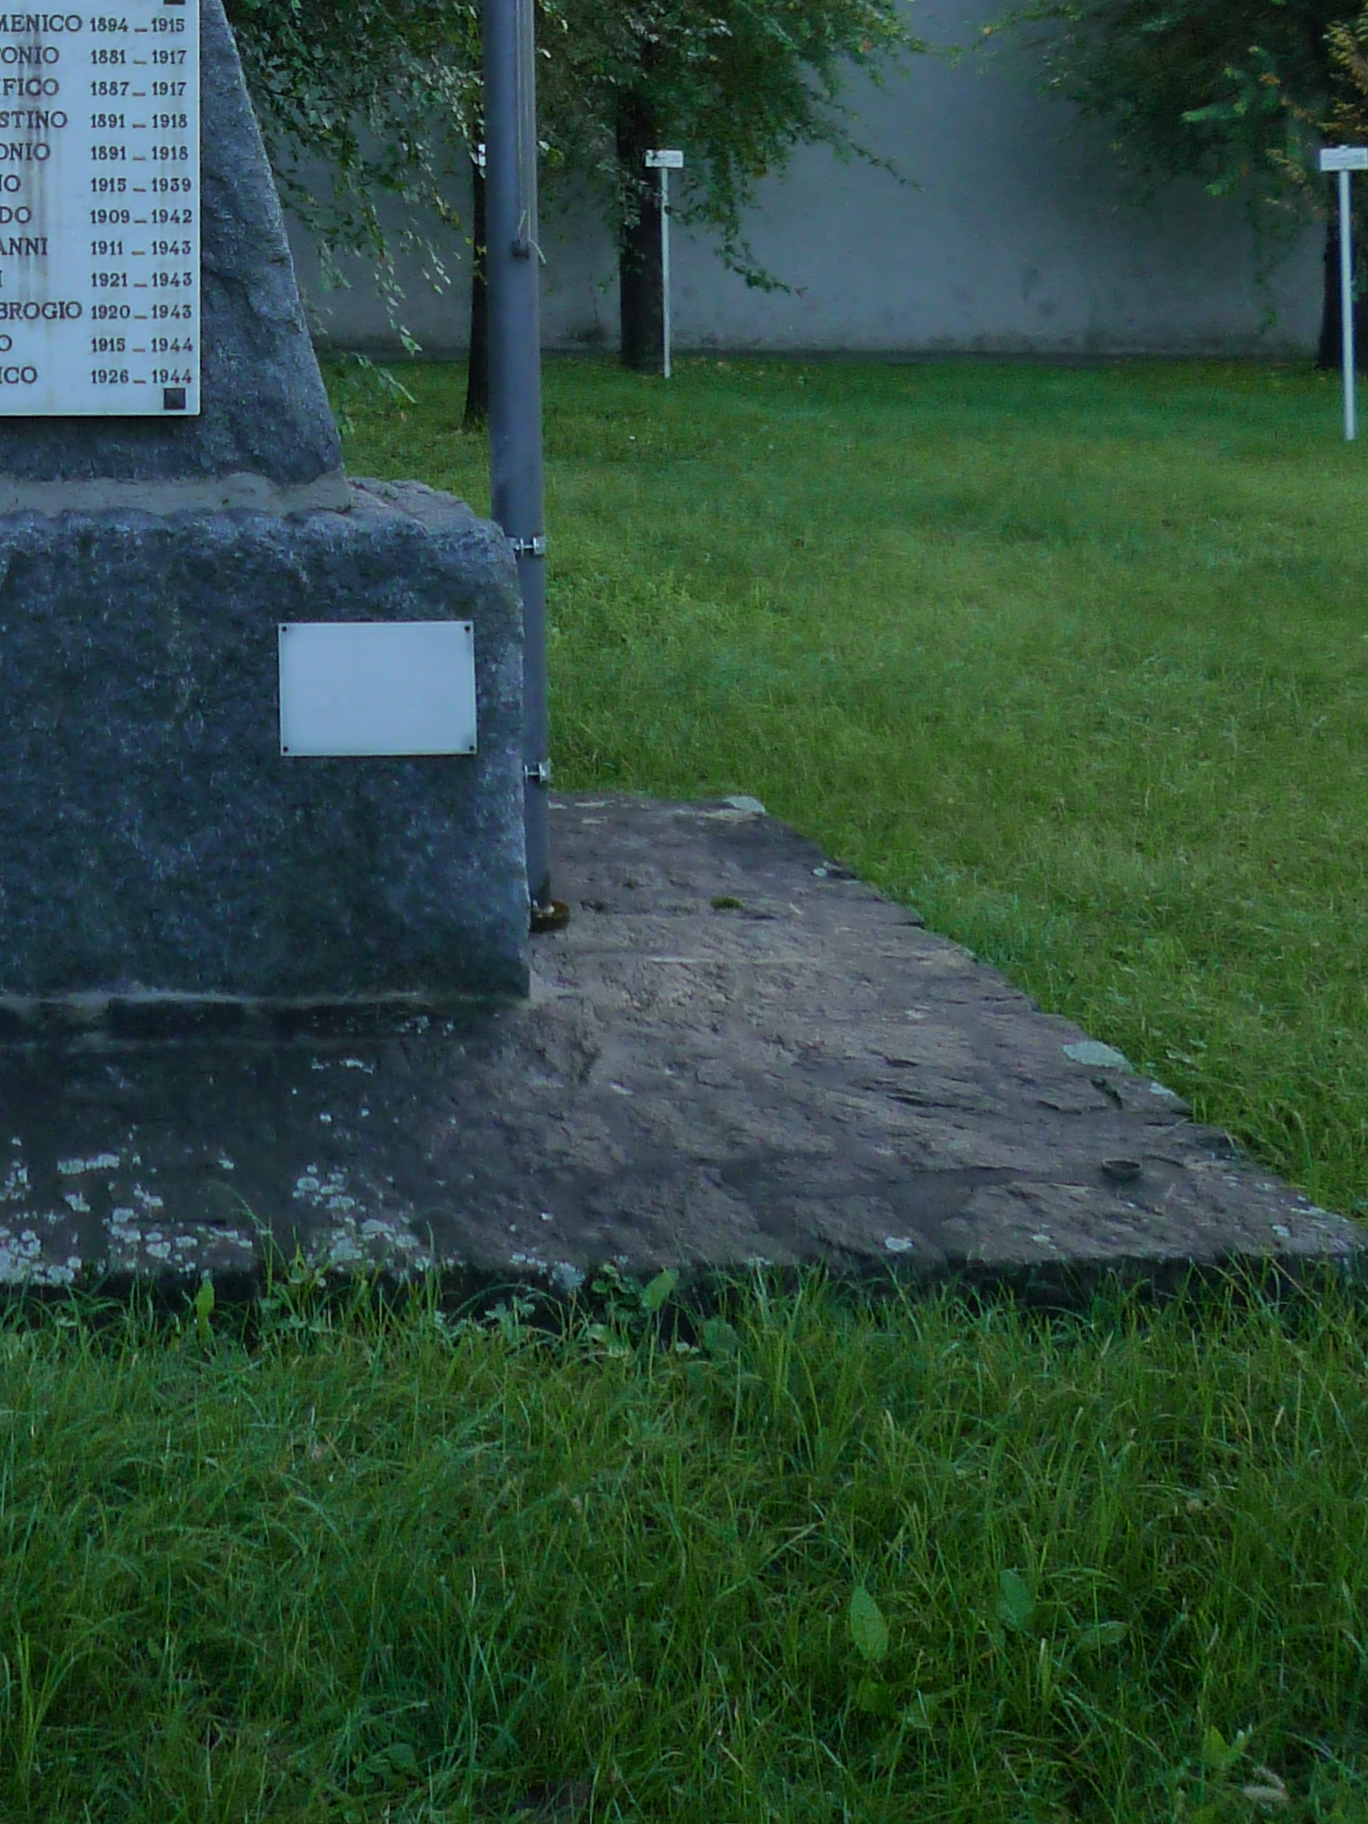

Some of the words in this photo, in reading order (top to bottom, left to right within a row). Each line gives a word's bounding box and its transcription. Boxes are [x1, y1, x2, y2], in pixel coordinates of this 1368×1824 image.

[89, 17, 128, 33] 1894
[150, 17, 185, 33] 1915
[90, 49, 126, 65] 1881
[151, 49, 187, 65] 1917
[90, 81, 130, 97] 1887
[151, 81, 187, 97] 1917
[90, 113, 125, 129] 1891
[151, 113, 188, 129] 1918
[90, 145, 126, 161] 1891
[151, 145, 189, 161] 1918
[90, 177, 126, 193] 1915
[151, 177, 192, 193] 1939
[90, 209, 130, 225] 1909
[151, 209, 192, 225] 1942
[90, 240, 123, 256] 1911
[151, 240, 192, 256] 1943
[90, 272, 128, 288] 1921
[151, 272, 192, 288] 1943
[90, 304, 131, 320] 1920
[151, 304, 192, 320] 1943
[90, 337, 126, 353] 1915
[151, 337, 194, 353] 1944
[90, 369, 129, 385] 1926
[151, 369, 193, 385] 1944
